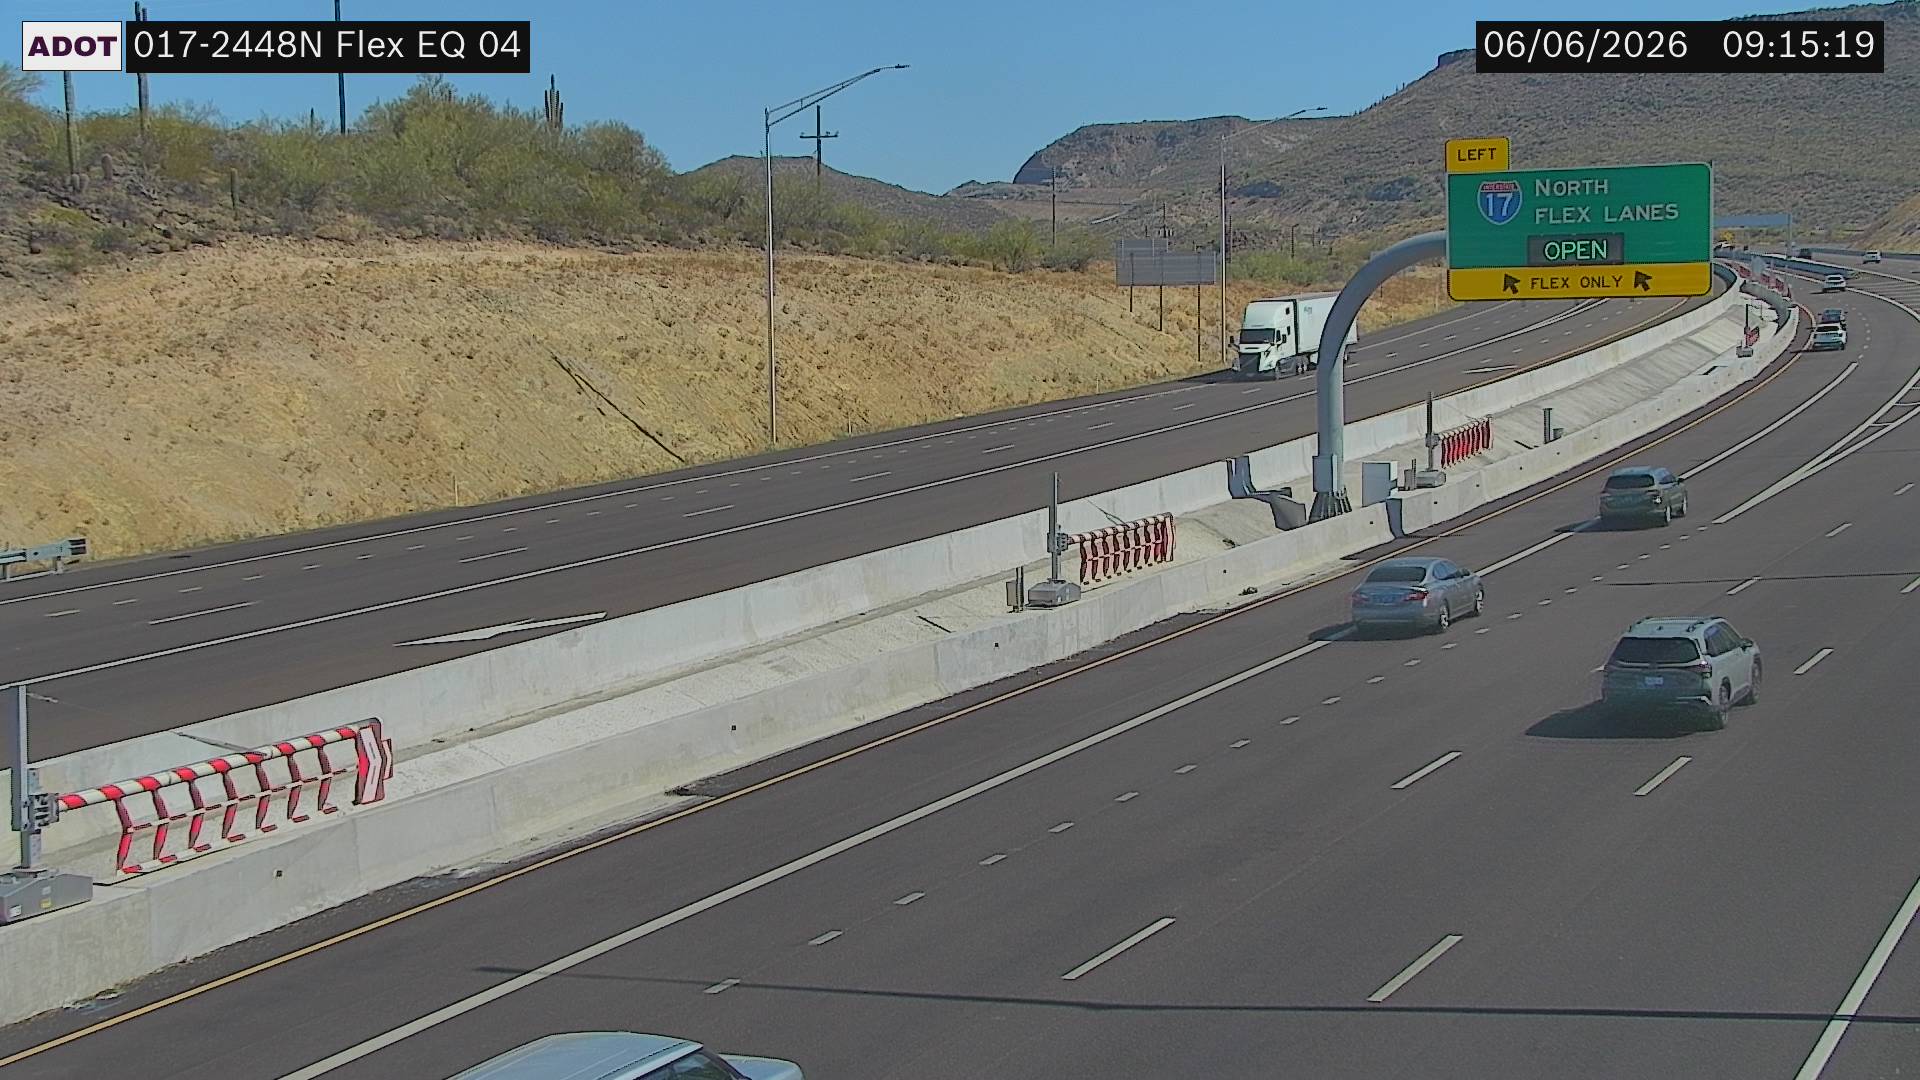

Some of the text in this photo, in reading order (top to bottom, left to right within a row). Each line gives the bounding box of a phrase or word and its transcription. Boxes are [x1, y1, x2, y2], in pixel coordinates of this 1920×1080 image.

[1457, 147, 1497, 162] LEFT
[1535, 178, 1609, 197] NORTH
[1486, 192, 1513, 217] 17
[1535, 203, 1679, 225] FLEX LANES
[1544, 239, 1607, 261] OPEN
[1530, 275, 1623, 290] FLEX ONLY
